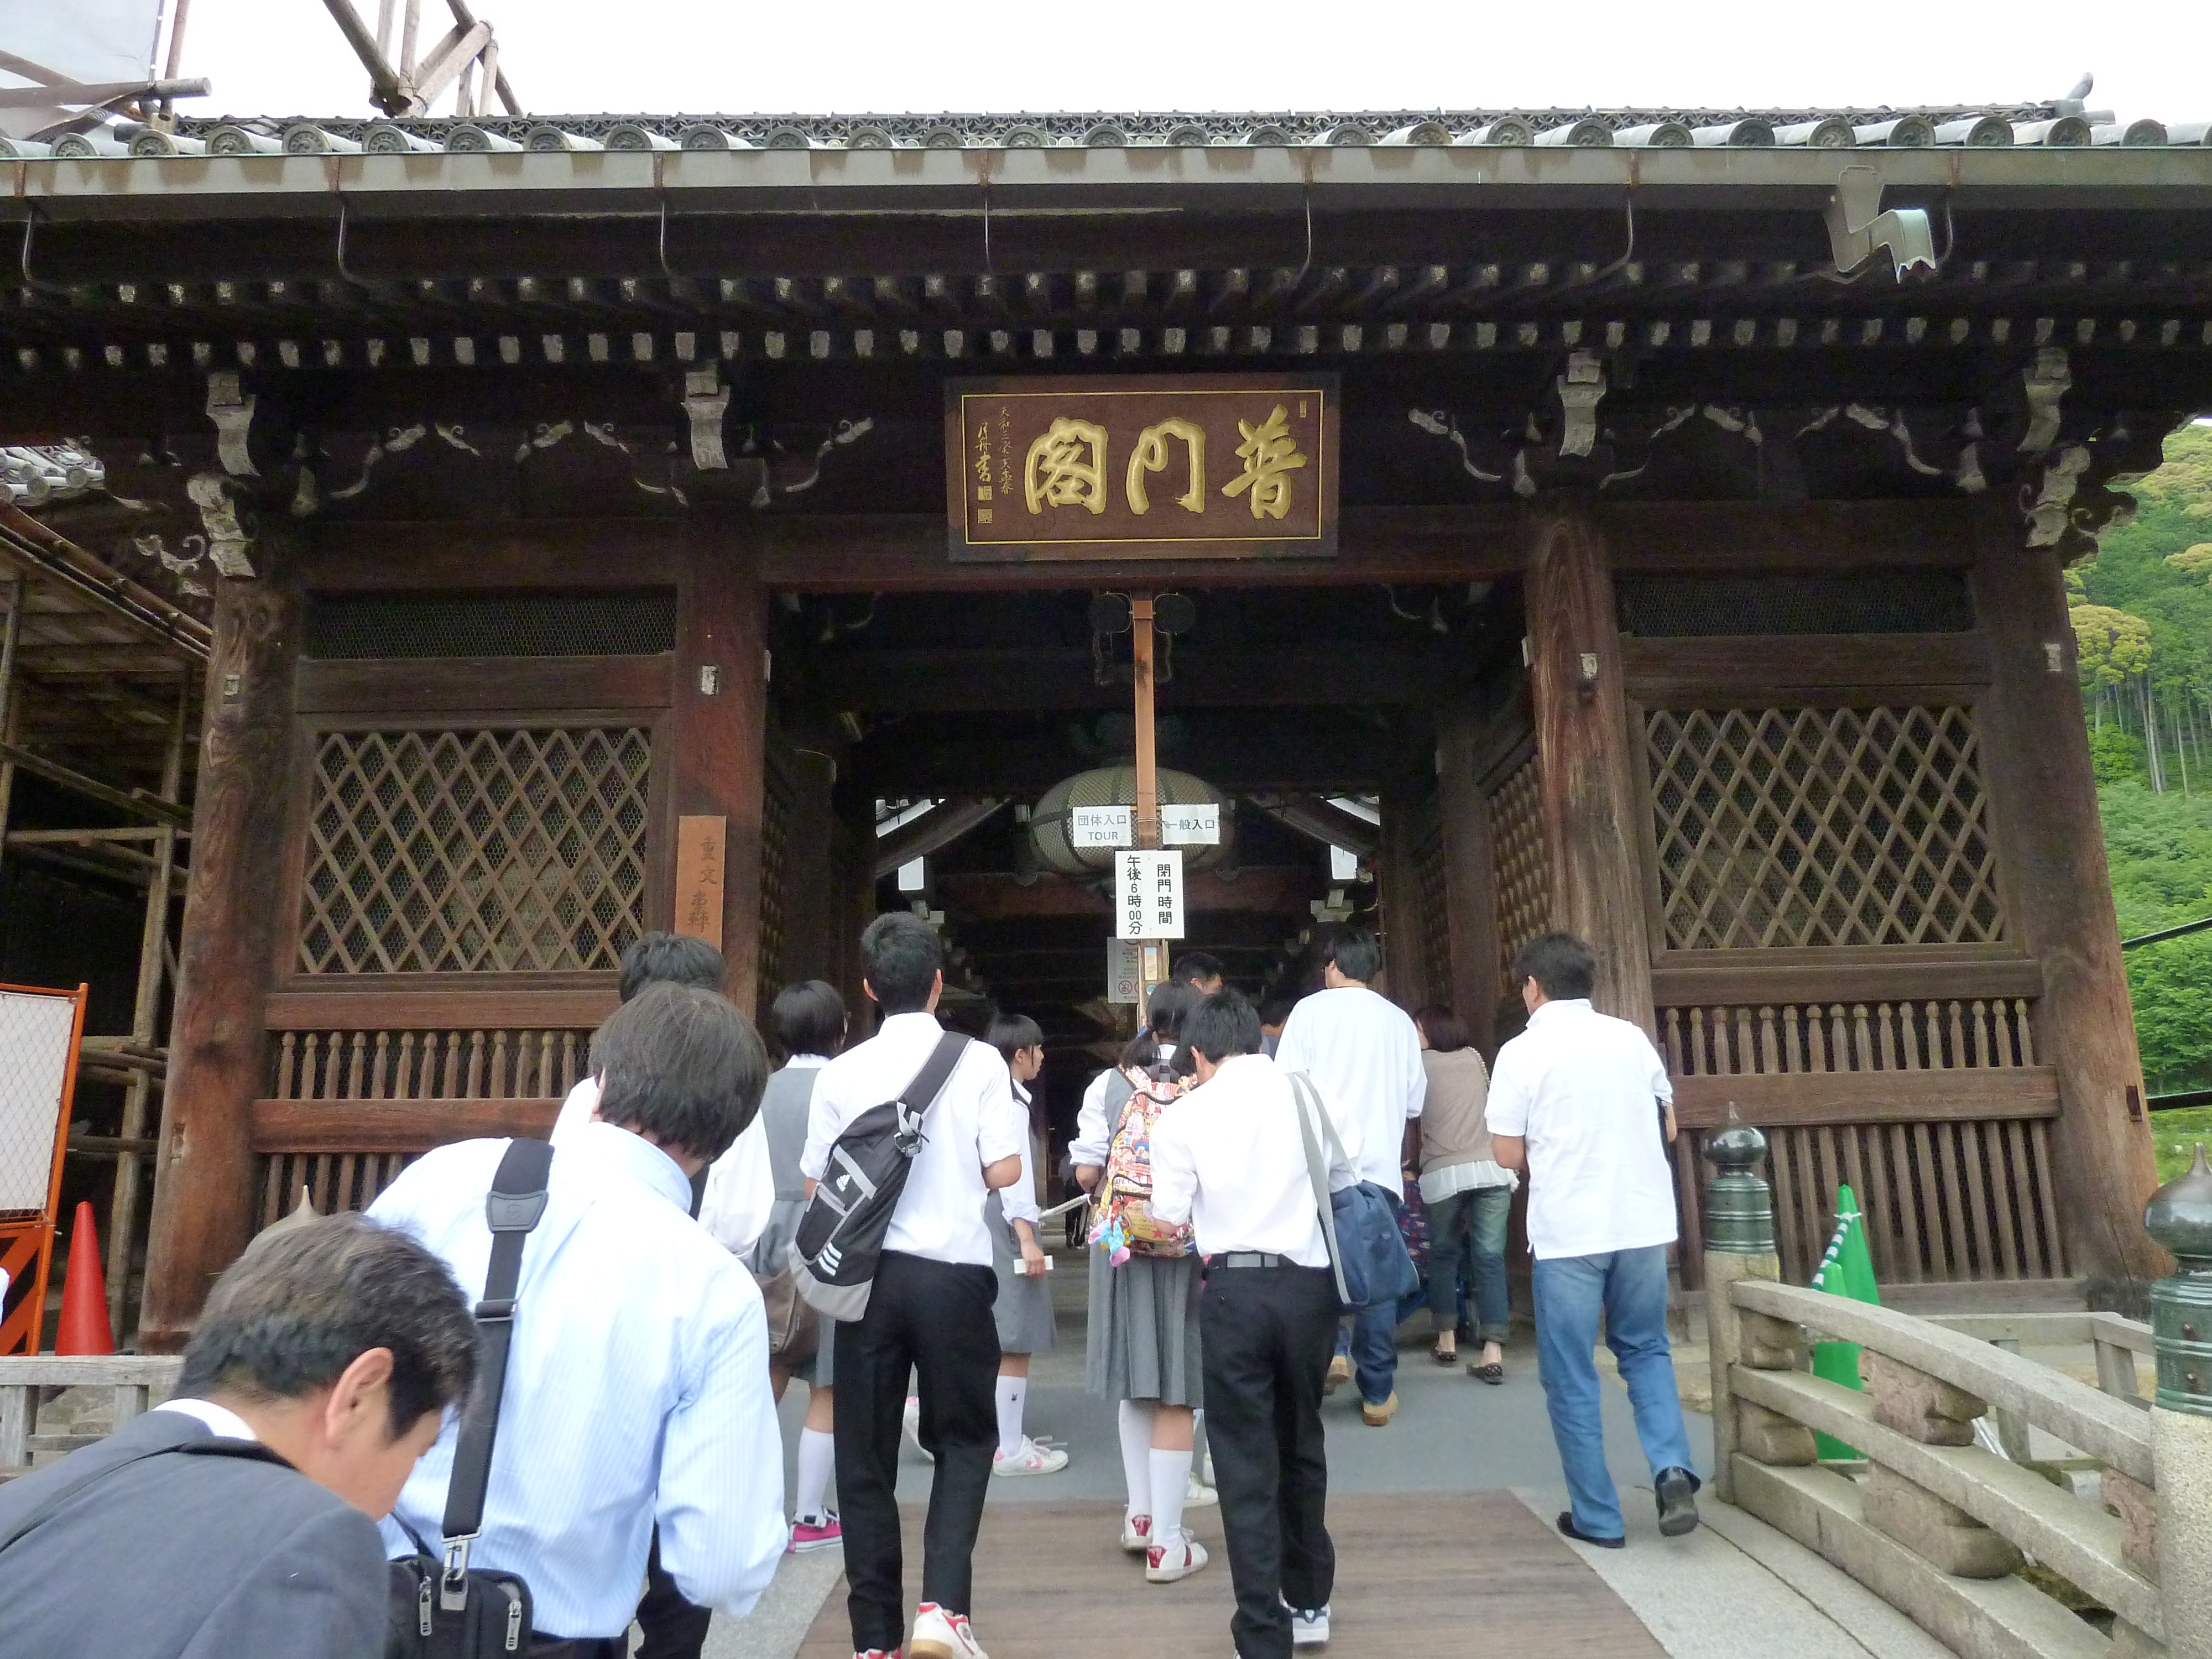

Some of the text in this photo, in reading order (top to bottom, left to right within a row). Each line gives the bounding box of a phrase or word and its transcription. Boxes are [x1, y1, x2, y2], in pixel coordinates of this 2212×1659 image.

[1024, 403, 1307, 520] 普門閣
[1077, 814, 1126, 826] 団体入口
[1088, 831, 1119, 841] TOUR
[1167, 818, 1215, 830] 一般入口
[1126, 854, 1143, 935] 午後6時00分
[1157, 864, 1173, 925] 閉門時間
